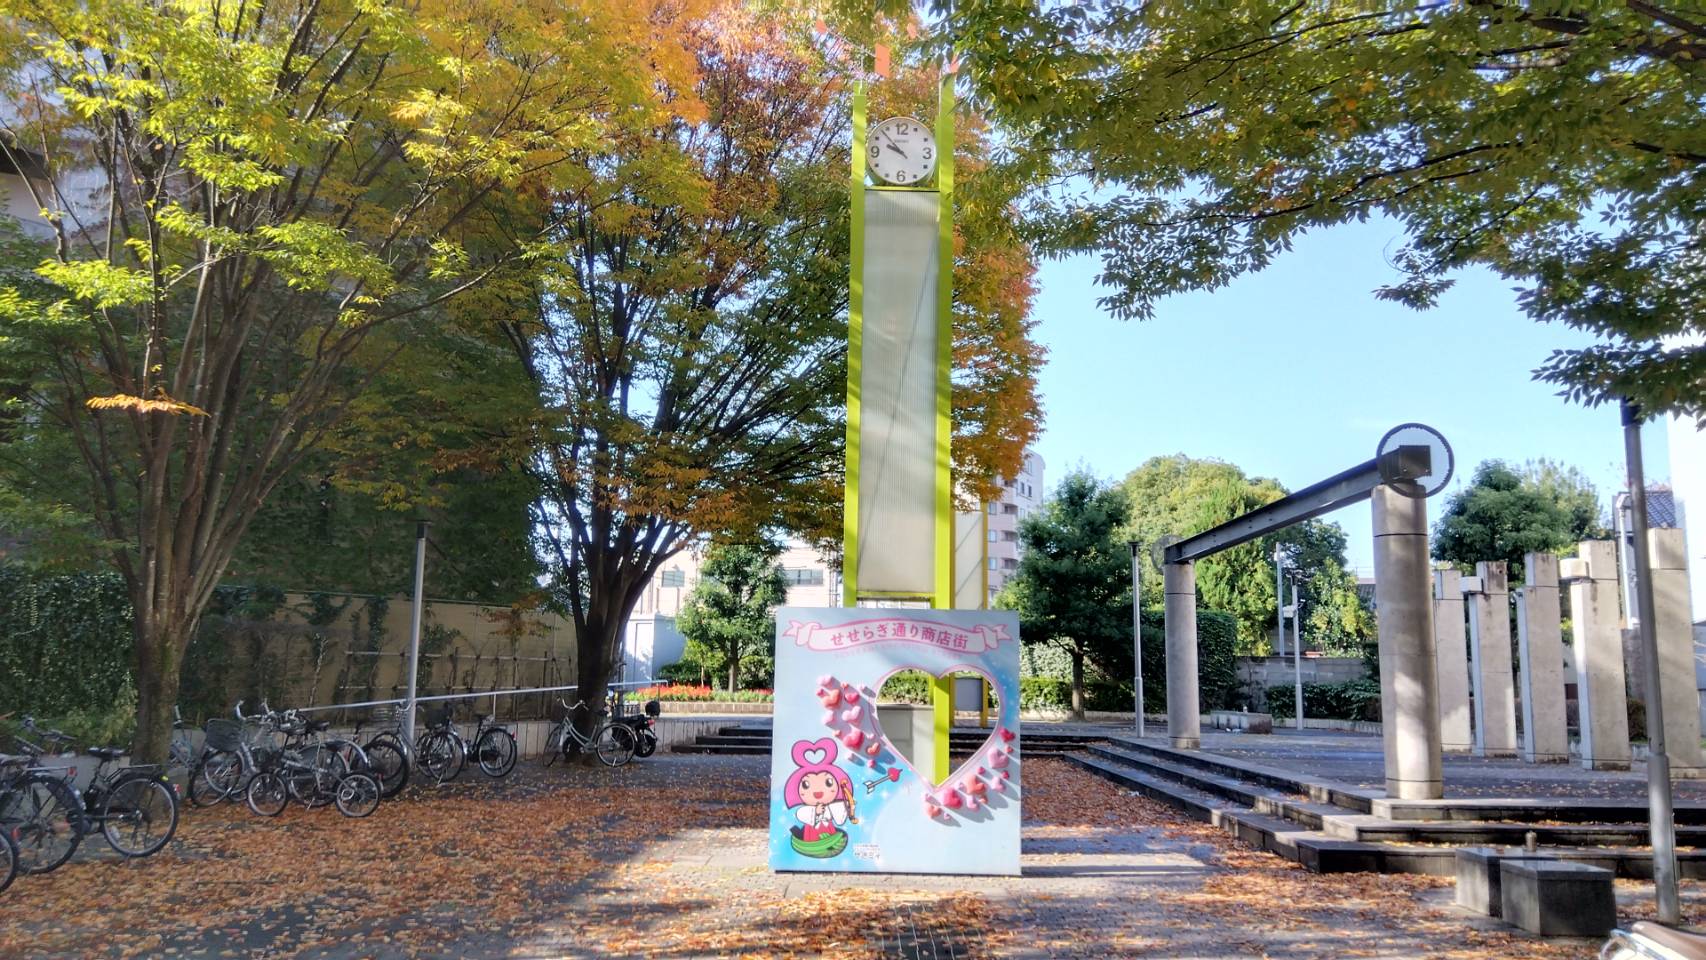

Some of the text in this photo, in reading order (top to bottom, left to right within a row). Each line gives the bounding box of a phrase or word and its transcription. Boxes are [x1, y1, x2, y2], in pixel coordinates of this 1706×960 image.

[895, 122, 909, 136] 12
[870, 145, 880, 159] 9
[922, 147, 932, 160] 3
[896, 170, 906, 182] 6
[831, 622, 968, 649] せせらぎ通り商店街
